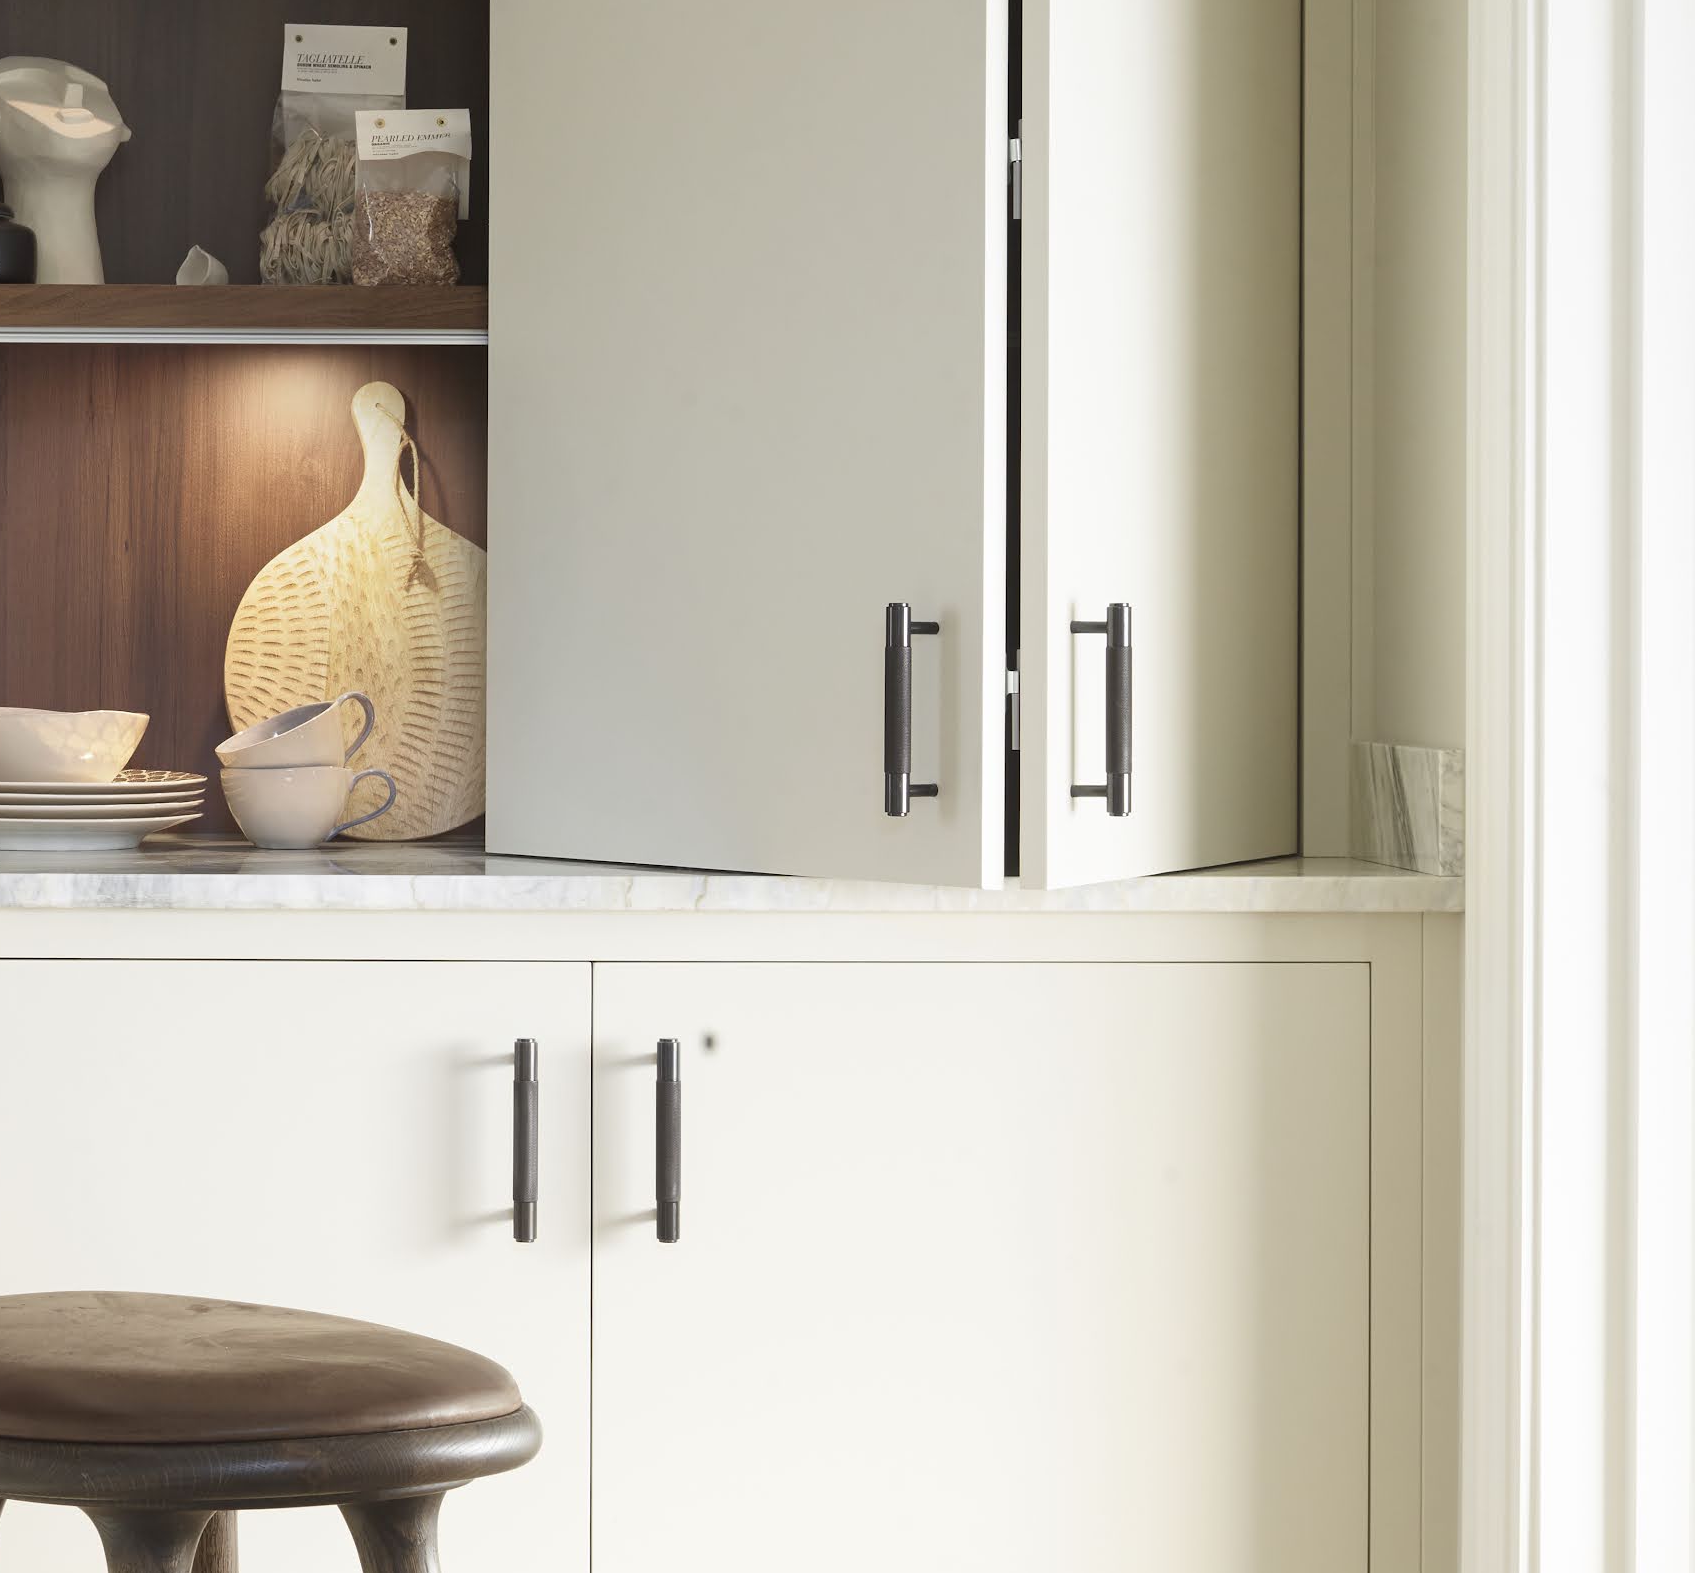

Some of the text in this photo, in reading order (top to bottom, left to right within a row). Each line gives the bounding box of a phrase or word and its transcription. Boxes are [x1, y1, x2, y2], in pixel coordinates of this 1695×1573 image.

[297, 53, 366, 64] TAGLIATELLE
[371, 132, 451, 142] PEARLED EMMER
